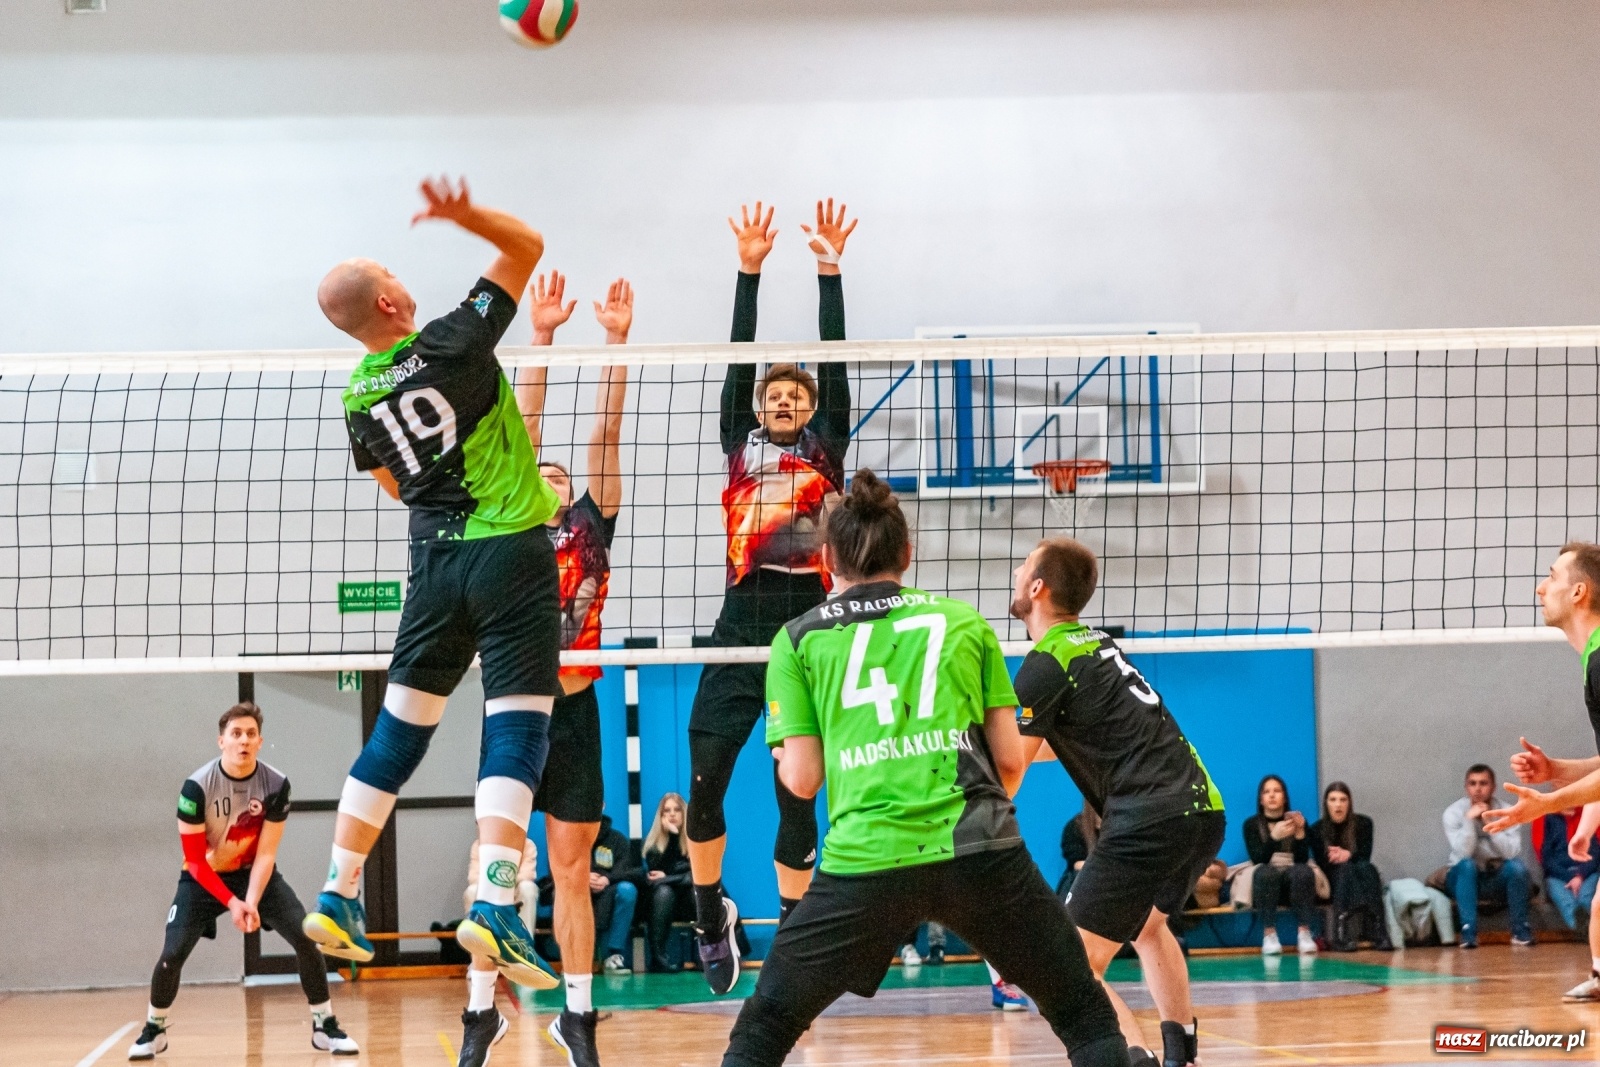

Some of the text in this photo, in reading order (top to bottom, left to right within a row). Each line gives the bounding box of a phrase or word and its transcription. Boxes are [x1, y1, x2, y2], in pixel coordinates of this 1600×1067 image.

[371, 353, 428, 392] RACIBORZ
[369, 387, 457, 475] 19
[344, 586, 396, 598] WYJŚCIE
[820, 593, 940, 620] KS RACIBORZ
[841, 613, 947, 726] 47
[1098, 647, 1161, 705] 3
[839, 728, 974, 772] NADSKAKULSKI
[213, 796, 231, 818] 10
